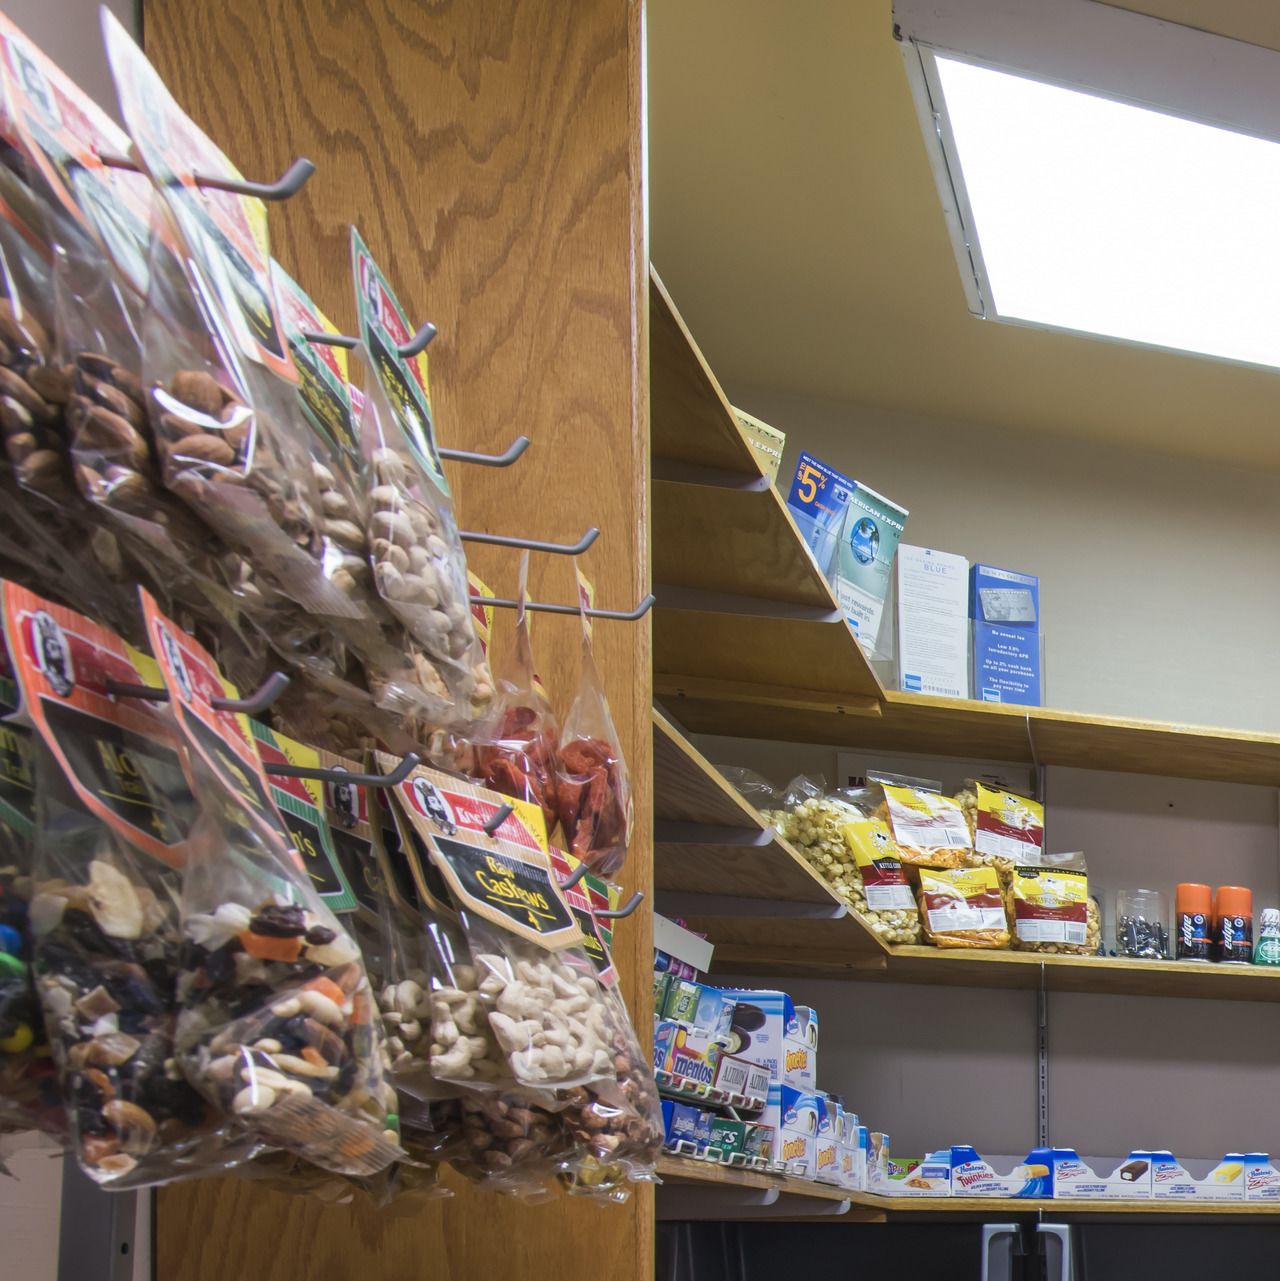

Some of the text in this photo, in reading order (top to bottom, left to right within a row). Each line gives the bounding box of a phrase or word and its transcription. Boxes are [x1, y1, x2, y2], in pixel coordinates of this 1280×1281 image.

[485, 855, 516, 880] Raw
[475, 870, 550, 911] Cashews
[674, 1053, 714, 1086] mentos
[721, 1066, 745, 1093] ALTOIDS
